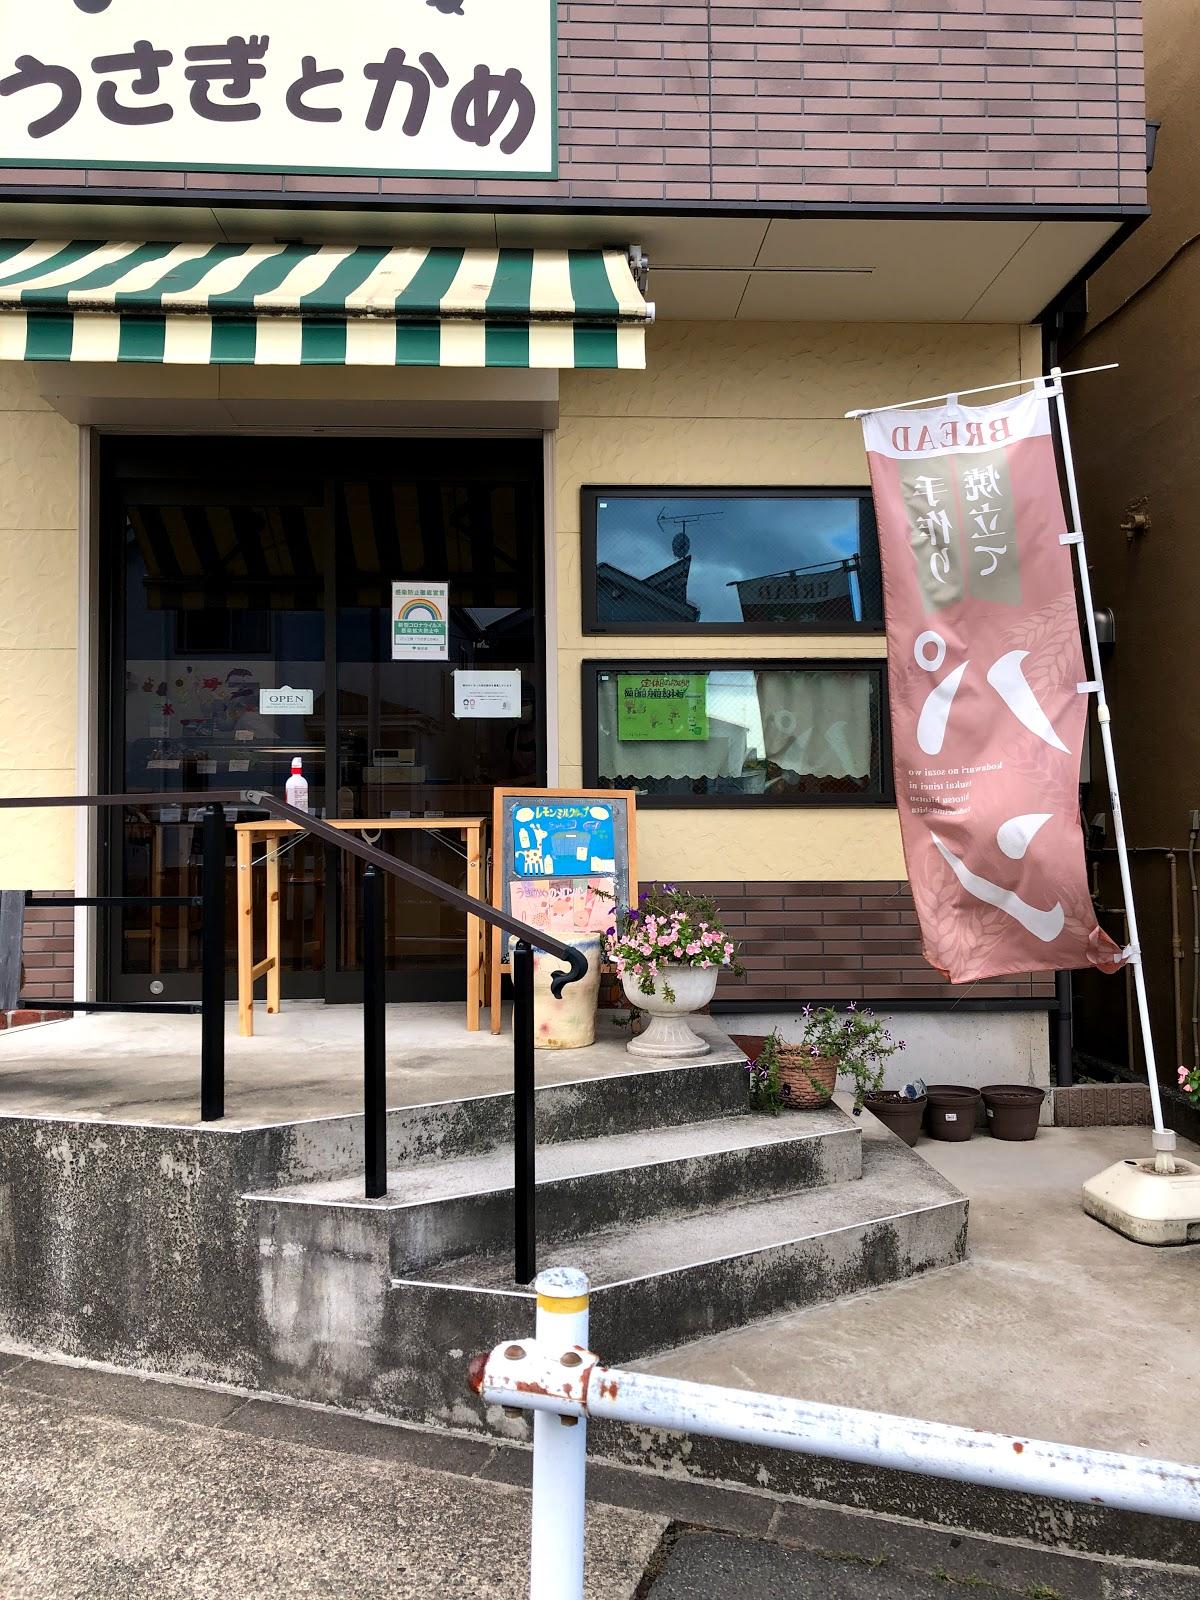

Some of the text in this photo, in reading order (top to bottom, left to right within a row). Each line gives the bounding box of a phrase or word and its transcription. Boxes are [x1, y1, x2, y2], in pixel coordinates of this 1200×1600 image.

[0, 35, 535, 155] うさぎとかめ
[269, 695, 304, 703] OPEN
